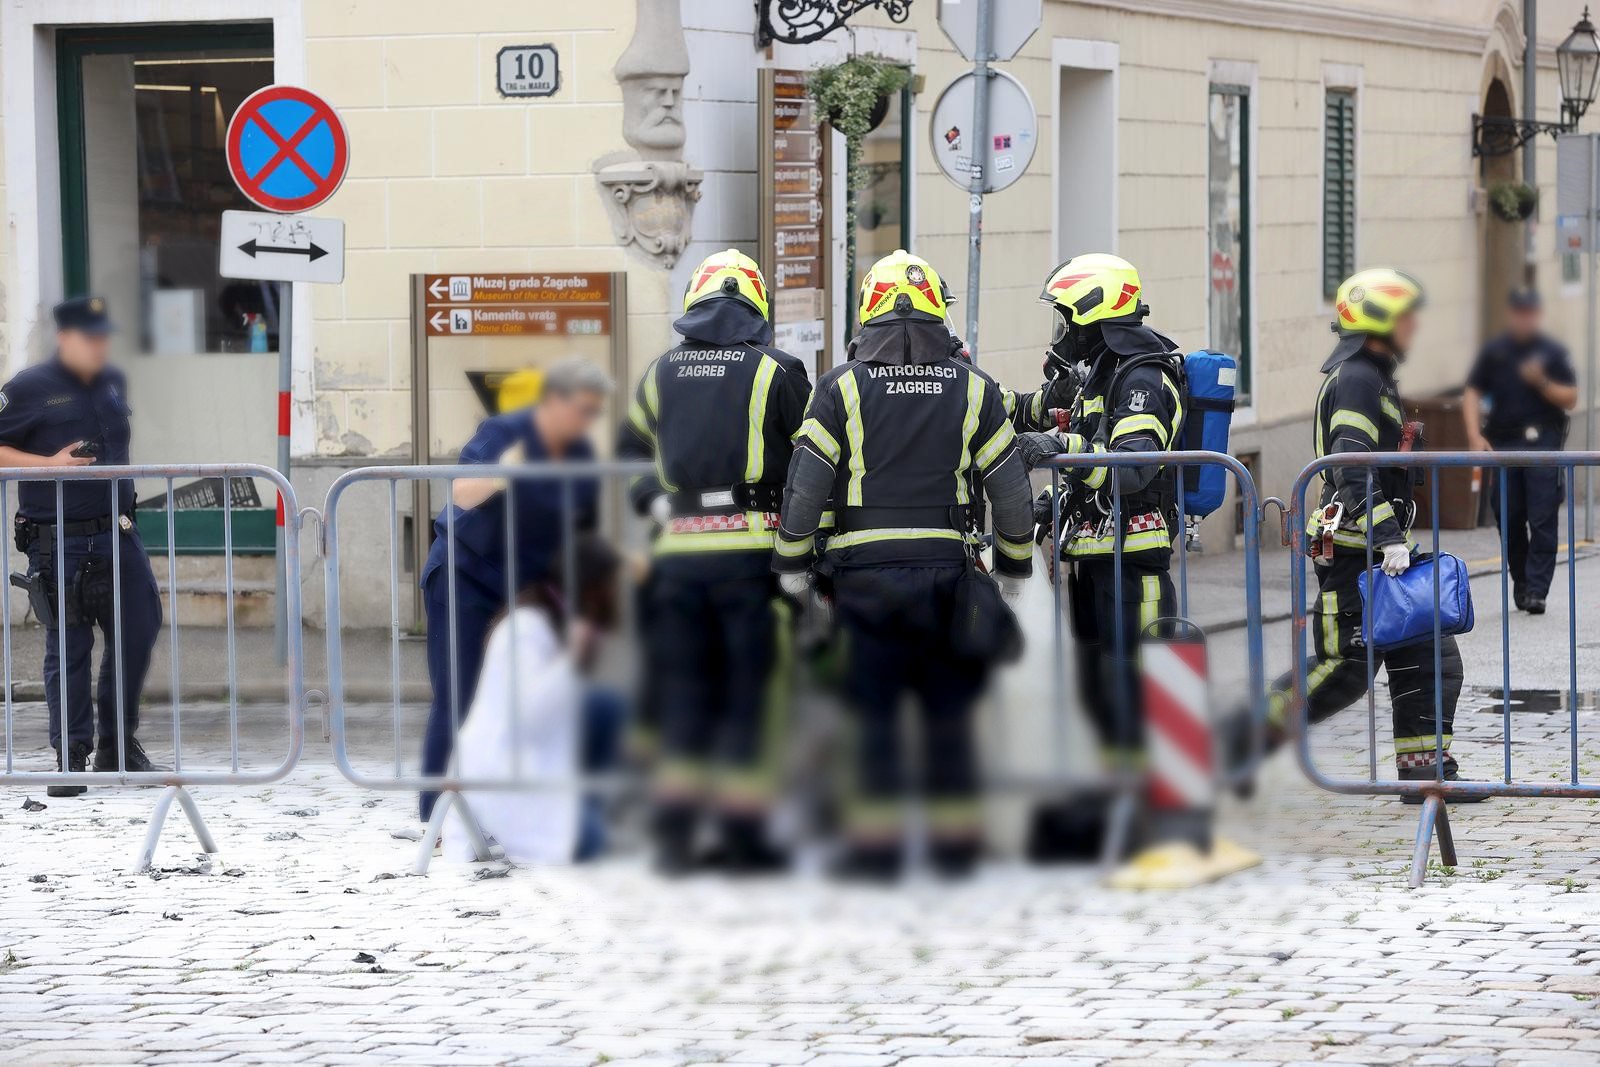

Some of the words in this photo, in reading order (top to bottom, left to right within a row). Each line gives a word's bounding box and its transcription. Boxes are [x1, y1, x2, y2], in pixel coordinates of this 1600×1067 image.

[515, 52, 544, 80] 10
[528, 81, 550, 90] MARKA
[473, 276, 507, 291] Muzej
[508, 276, 541, 291] grada
[542, 276, 588, 291] Zagreba
[473, 291, 512, 300] Museum
[540, 291, 558, 301] City
[569, 290, 602, 301] Zagreb
[474, 309, 526, 321] Kamenita
[527, 310, 557, 321] vrata
[474, 324, 501, 333] Stone
[502, 323, 523, 332] Gate
[669, 350, 746, 363] VATROGASCI
[677, 364, 726, 378] ZAGREB
[867, 364, 958, 379] VATROGASCI
[885, 381, 943, 395] ZAGREB
